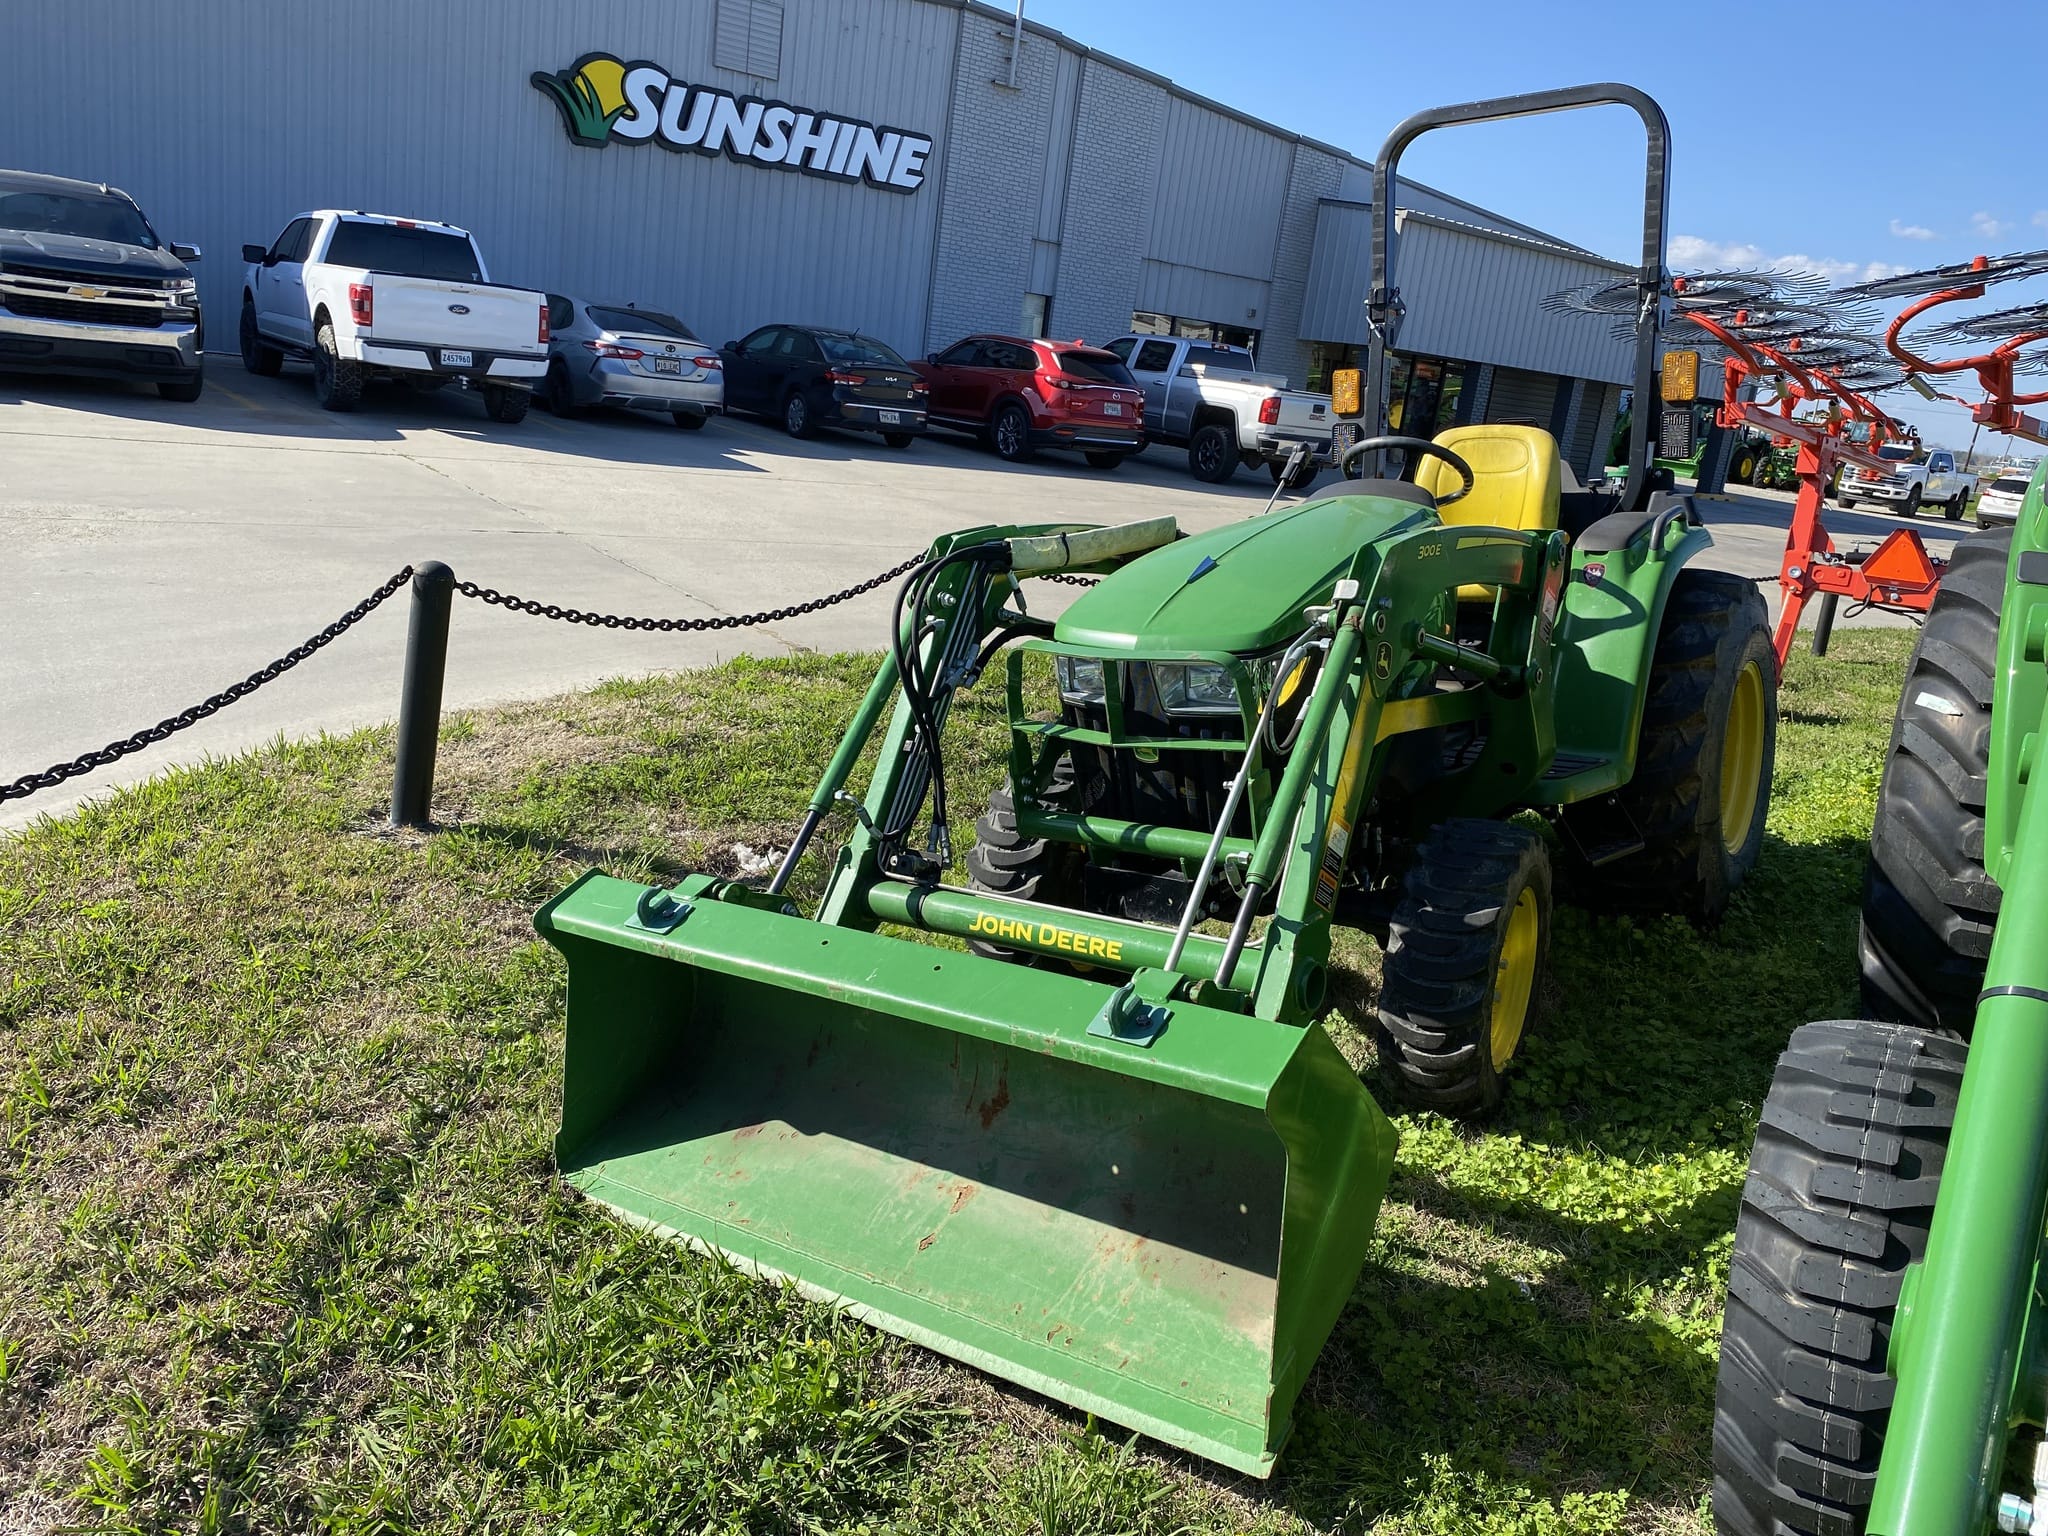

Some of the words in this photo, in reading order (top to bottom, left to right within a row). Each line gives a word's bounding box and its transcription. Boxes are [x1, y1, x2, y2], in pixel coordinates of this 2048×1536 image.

[612, 67, 932, 189] SUNSHINE
[442, 353, 471, 364] Z457960
[969, 911, 1033, 942] JOHN
[1038, 923, 1123, 961] DEERE
